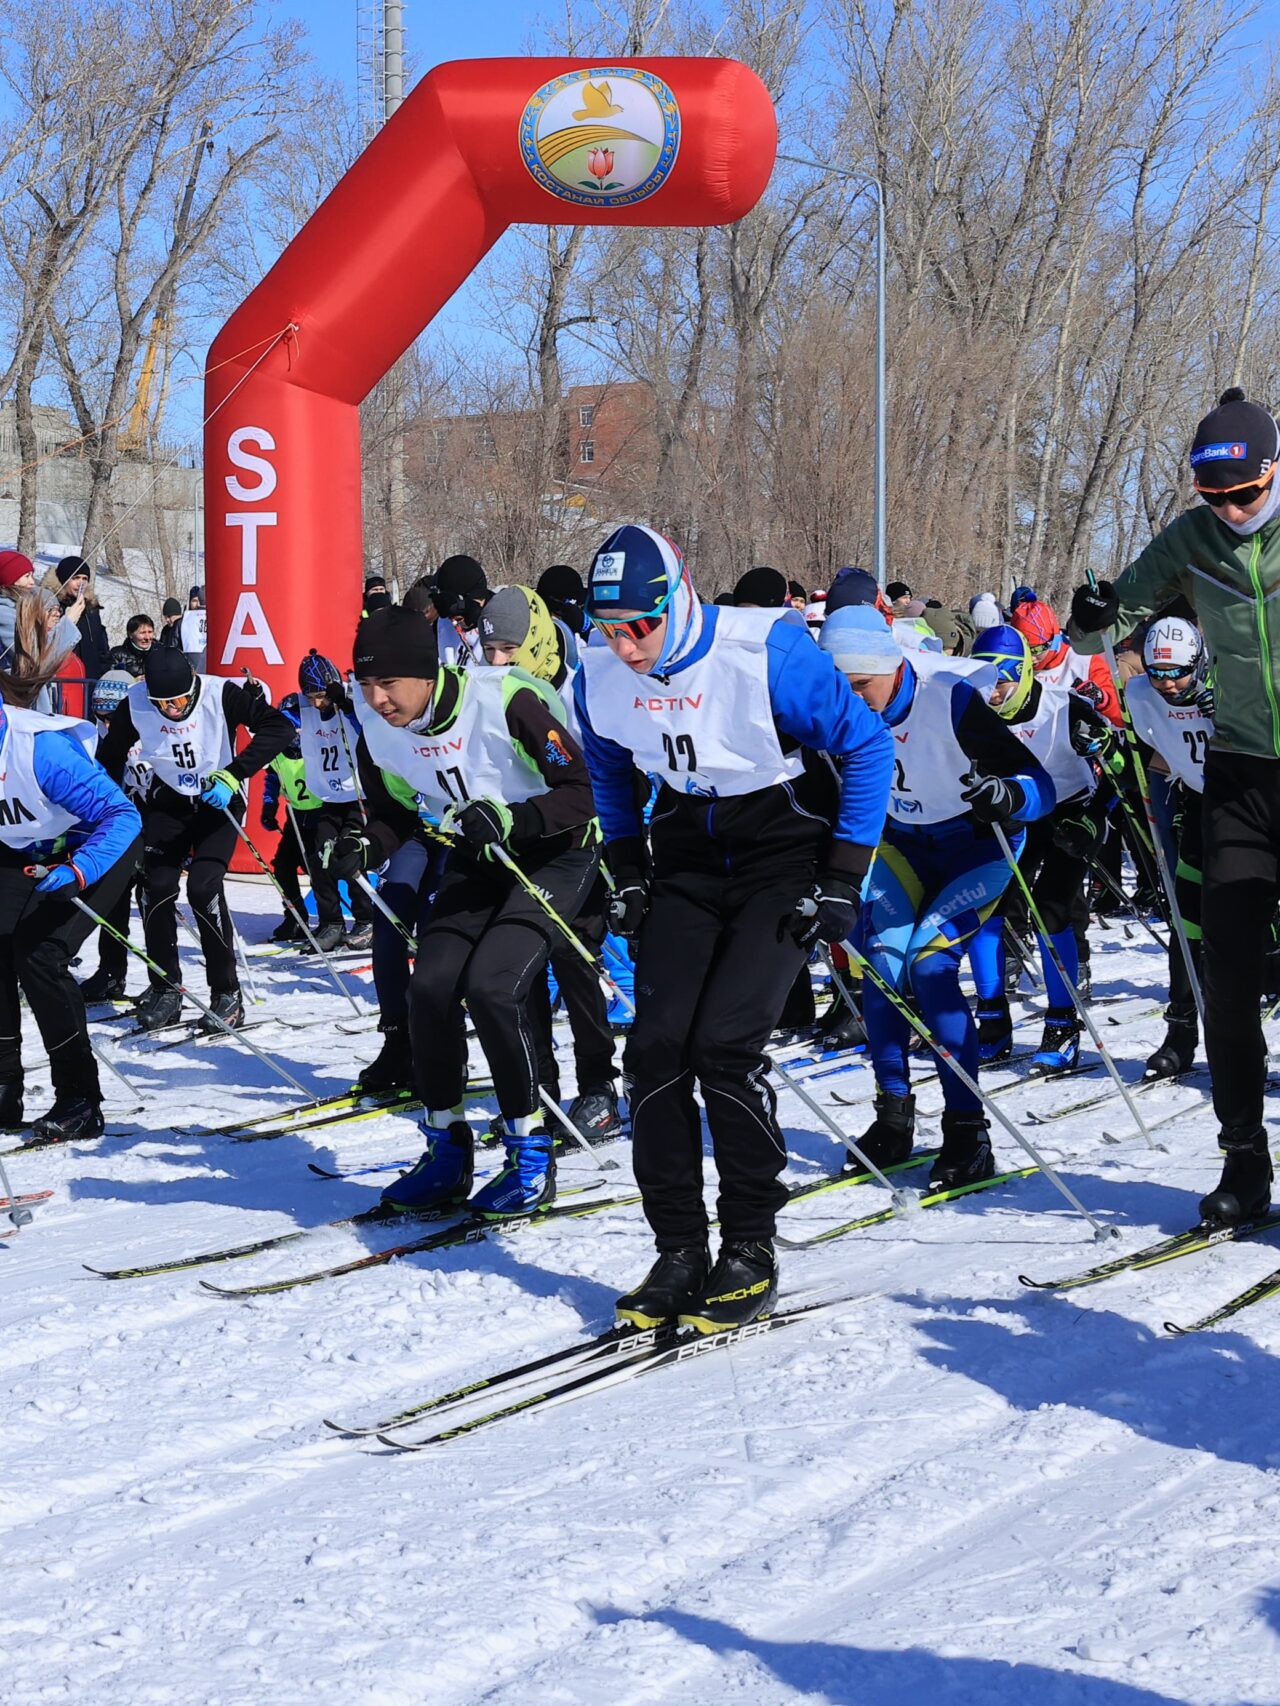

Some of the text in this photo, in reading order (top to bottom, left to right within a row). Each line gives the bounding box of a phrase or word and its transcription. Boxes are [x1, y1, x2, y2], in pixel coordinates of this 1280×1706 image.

[632, 693, 703, 711] ACTIV
[160, 722, 197, 735] ACTIV
[171, 742, 196, 769] 55
[321, 746, 339, 772] 22
[294, 779, 310, 800] 2
[920, 882, 987, 930] sportful
[464, 1218, 531, 1243] FISCHER
[705, 1278, 770, 1305] FISCHER
[676, 1322, 771, 1362] FISCHER
